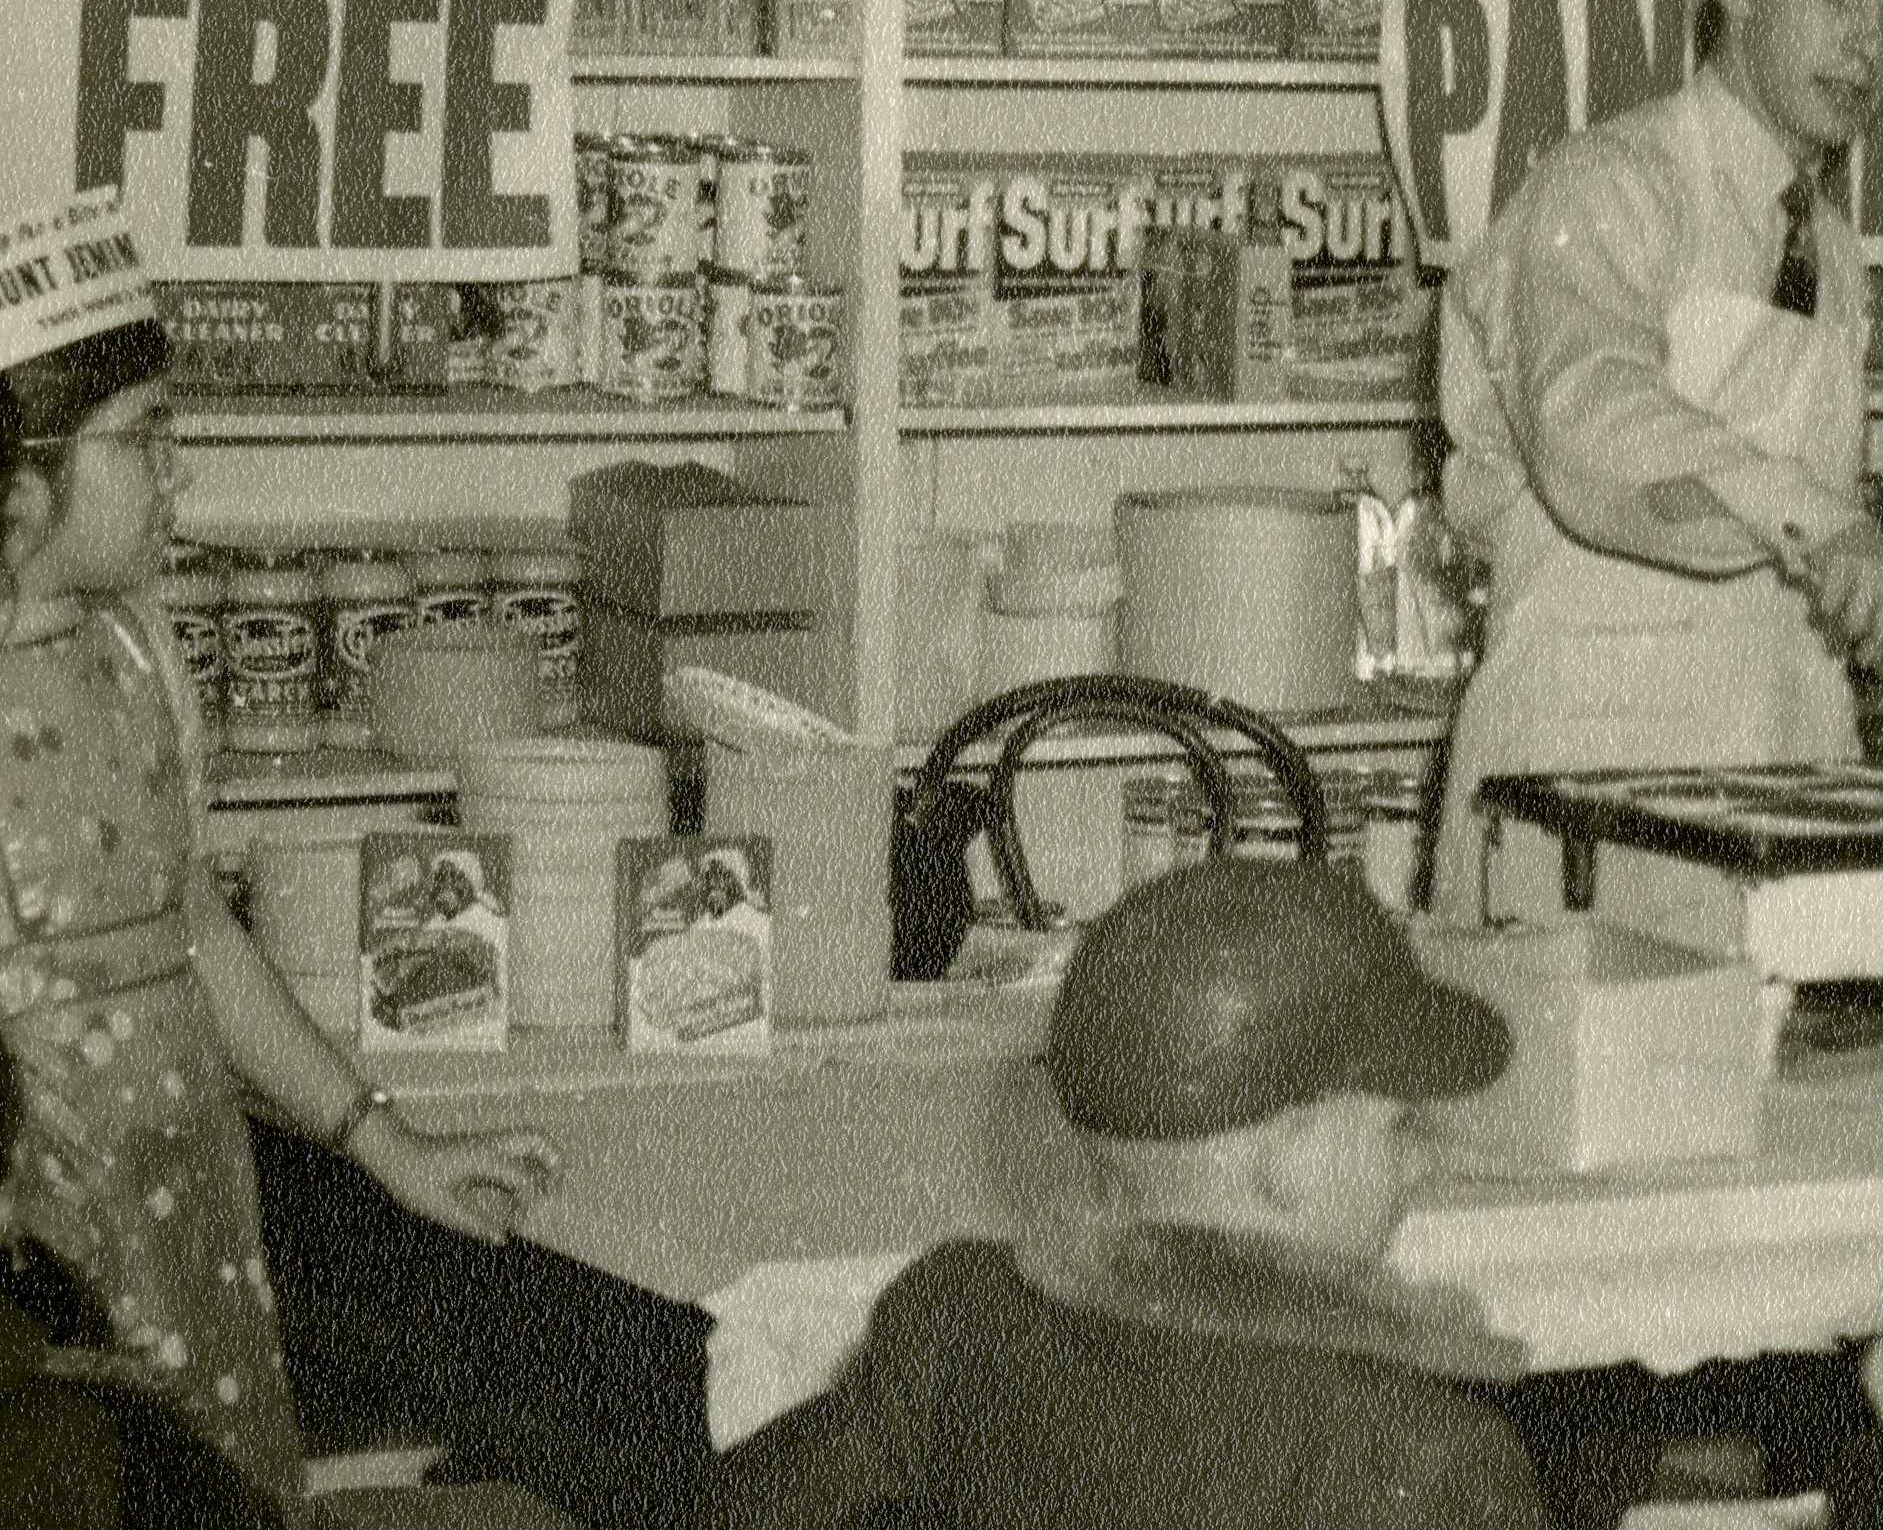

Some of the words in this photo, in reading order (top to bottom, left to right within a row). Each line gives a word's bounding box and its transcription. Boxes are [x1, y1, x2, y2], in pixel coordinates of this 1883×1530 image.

[898, 180, 994, 270] urf
[1002, 175, 1144, 270] Surf
[0, 254, 58, 311] UNT
